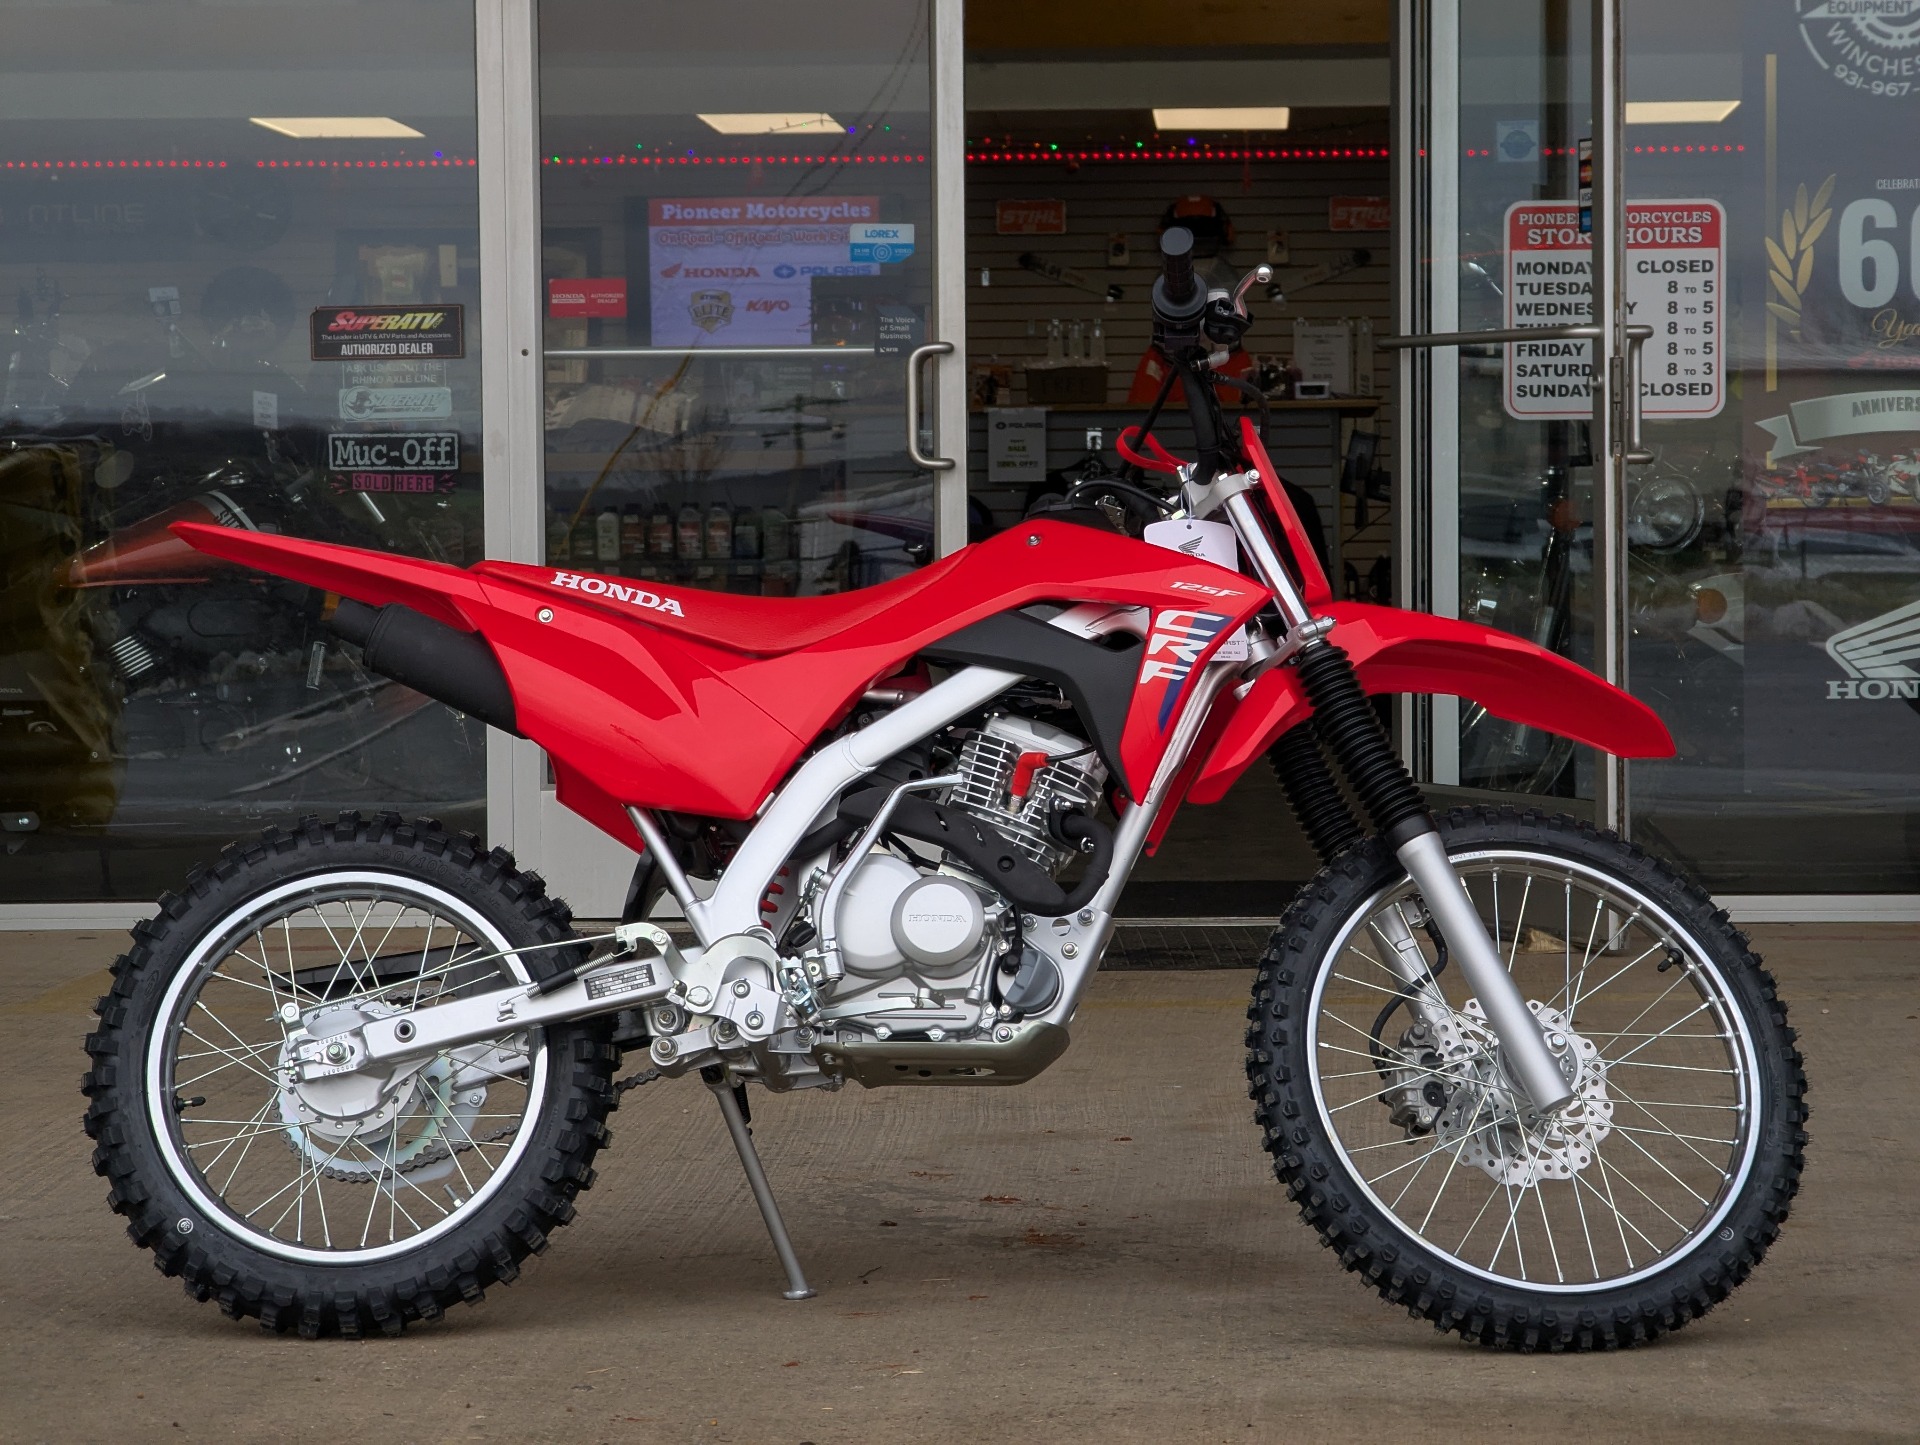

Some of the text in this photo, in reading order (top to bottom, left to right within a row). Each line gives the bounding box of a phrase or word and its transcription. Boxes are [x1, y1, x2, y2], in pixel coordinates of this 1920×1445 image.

[1828, 0, 1913, 14] EQUIPMENT
[662, 203, 871, 221] Pioneer Motorcycles
[1003, 209, 1060, 225] STIHL
[1519, 213, 1579, 226] PIONEE
[865, 230, 899, 239] LOREX
[1528, 228, 1592, 245] STOR
[684, 267, 760, 279] HONDA
[801, 265, 872, 276] POLARIS
[1637, 260, 1714, 274] CLOSED
[1516, 280, 1714, 296] TUESDA 8 TO 5
[1667, 300, 1678, 314] 8
[1685, 306, 1697, 314] TO
[1703, 300, 1714, 314] 5
[1667, 321, 1714, 335] 8 TO 5
[880, 332, 911, 340] Business
[341, 343, 433, 356] AUTHORIZED DEALER
[1516, 341, 1714, 357] FRIDAY 8 TO 5
[346, 362, 442, 374] ASK US ABOUT THE
[1516, 362, 1714, 378] SATURD 8 TO 3
[352, 374, 437, 385] RHINO AXLE LINE
[1641, 383, 1713, 397] CLOSED
[335, 438, 452, 465] Muc-Off
[354, 474, 433, 491] SOLD HERE
[551, 571, 685, 617] HONDA
[1170, 581, 1246, 597] 125F
[1140, 609, 1224, 684] CRF
[1826, 680, 1920, 699] HON
[908, 914, 967, 923] HONDA
